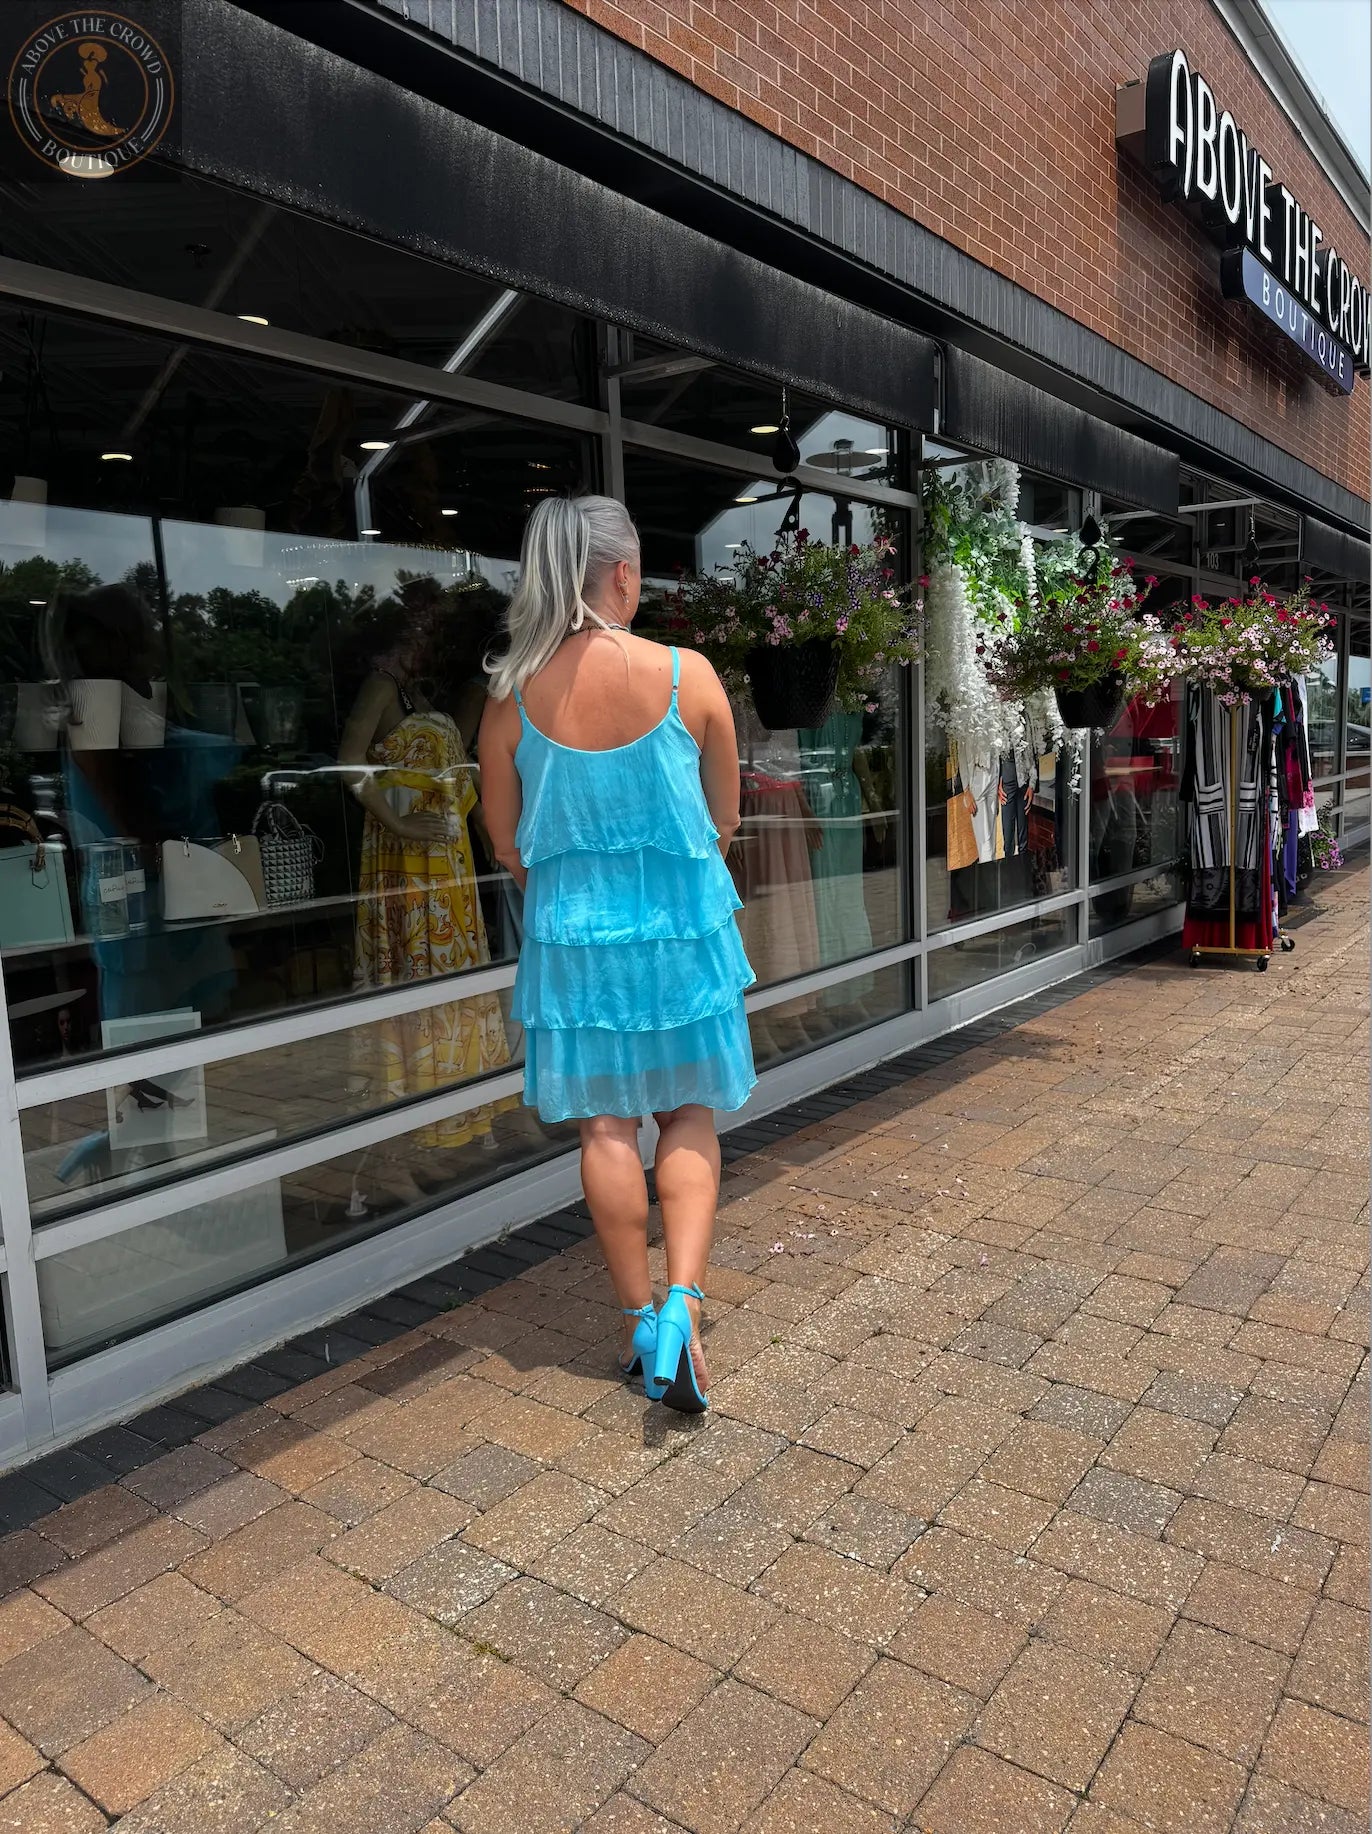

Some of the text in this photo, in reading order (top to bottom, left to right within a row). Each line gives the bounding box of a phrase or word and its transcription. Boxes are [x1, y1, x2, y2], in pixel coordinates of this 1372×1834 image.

[1170, 49, 1272, 264] ABOVE
[1281, 183, 1322, 314] THE
[1262, 275, 1345, 379] BOUTIQUE
[1206, 552, 1219, 570] 103
